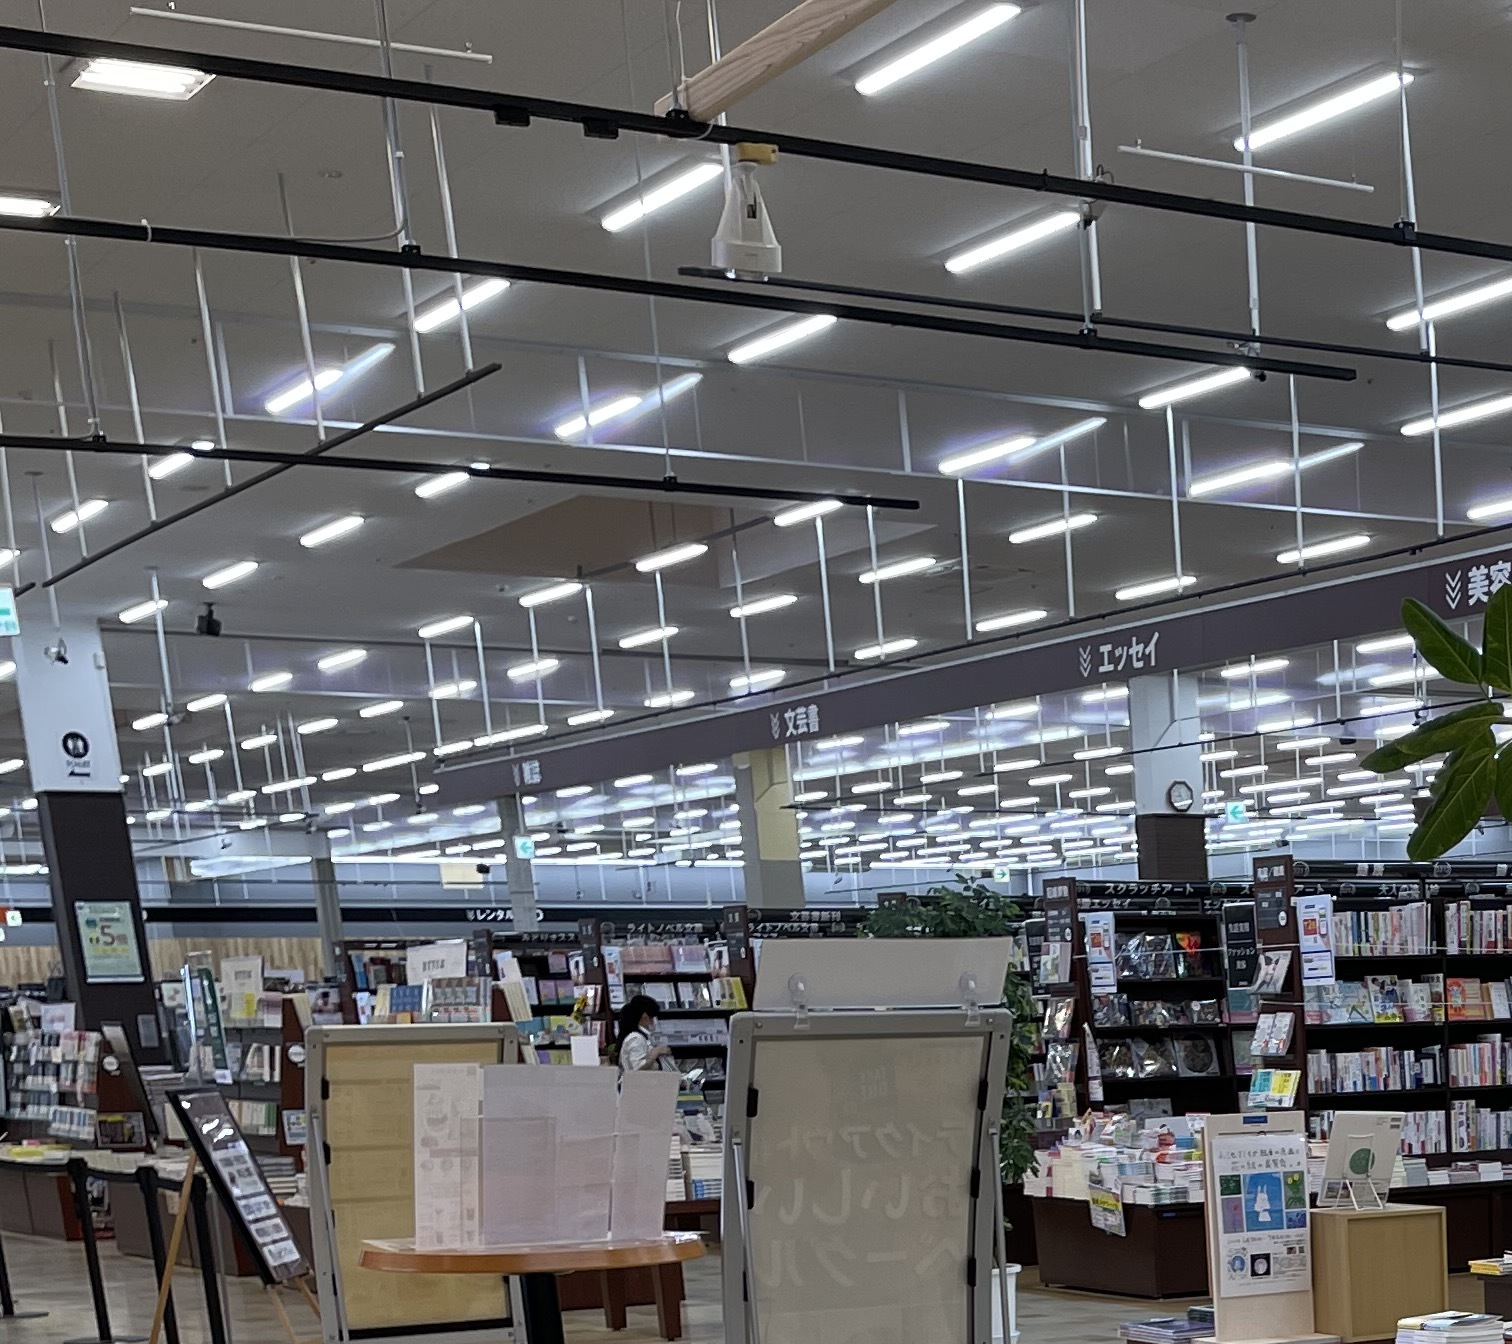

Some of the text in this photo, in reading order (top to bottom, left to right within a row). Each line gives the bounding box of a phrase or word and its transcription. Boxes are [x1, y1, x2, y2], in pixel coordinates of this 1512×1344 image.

[1098, 631, 1159, 673] エッセイ
[784, 703, 820, 738] 文芸書
